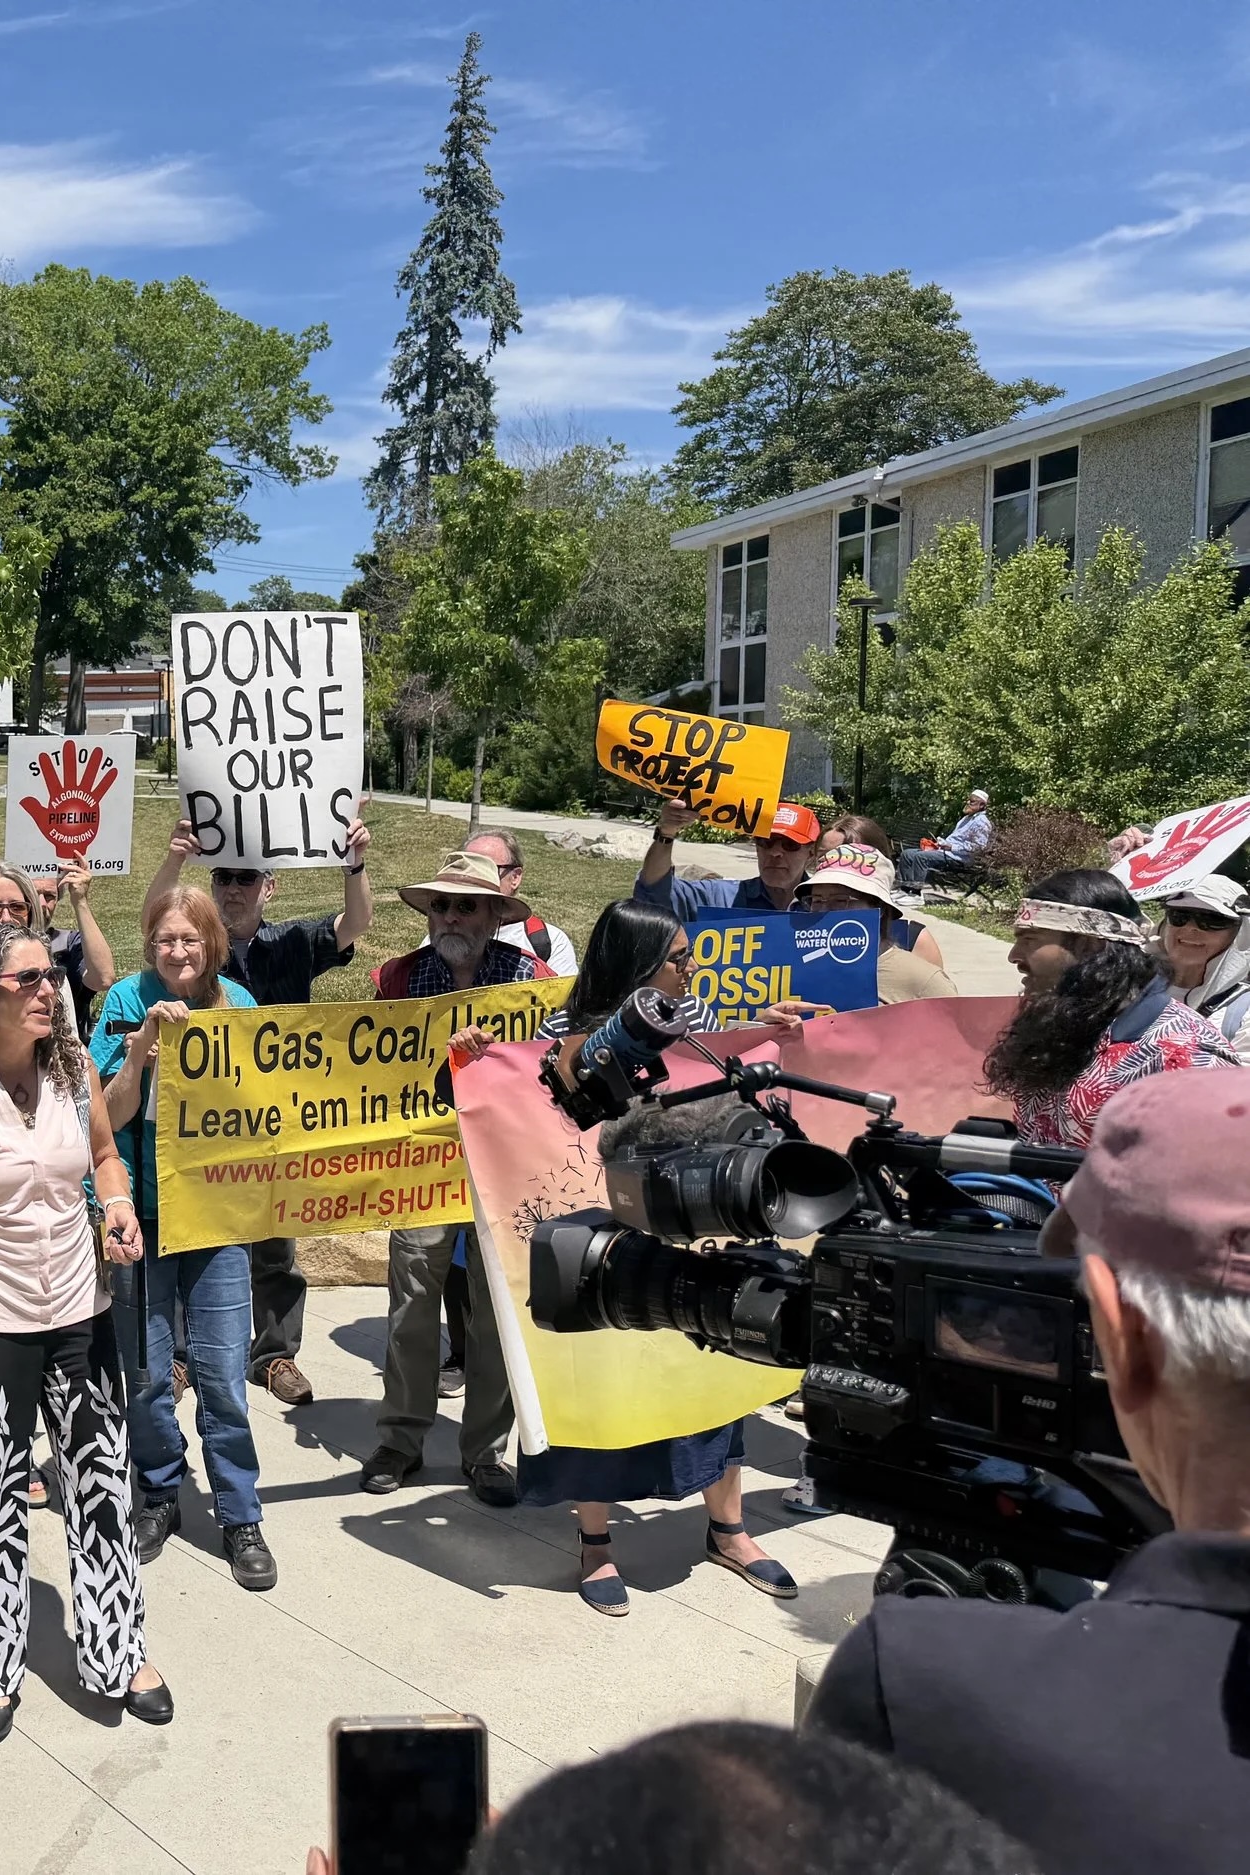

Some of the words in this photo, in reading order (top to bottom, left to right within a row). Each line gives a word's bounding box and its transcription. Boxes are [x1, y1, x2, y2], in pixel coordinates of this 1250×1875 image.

[181, 614, 348, 686] DON'T
[181, 685, 344, 750] RAISE
[629, 709, 747, 763] STOP
[28, 748, 114, 777] STOP
[226, 748, 313, 792] OUR
[610, 744, 735, 794] PROJECT
[48, 811, 97, 825] PIPELINE
[51, 789, 97, 809] ALGONQUIN
[49, 828, 95, 844] EXPANSION!
[186, 787, 353, 860] BILLS
[692, 925, 765, 967] OFF
[796, 938, 828, 949] WATER
[831, 937, 865, 946] WATCH
[689, 965, 802, 1006] OSSIL
[179, 1024, 242, 1087] Oil,
[253, 1021, 333, 1076] Gas,
[348, 1012, 436, 1068] Coal,
[178, 1100, 282, 1139] Leave
[292, 1091, 348, 1132] 'em
[360, 1085, 388, 1125] in
[400, 1080, 449, 1120] the
